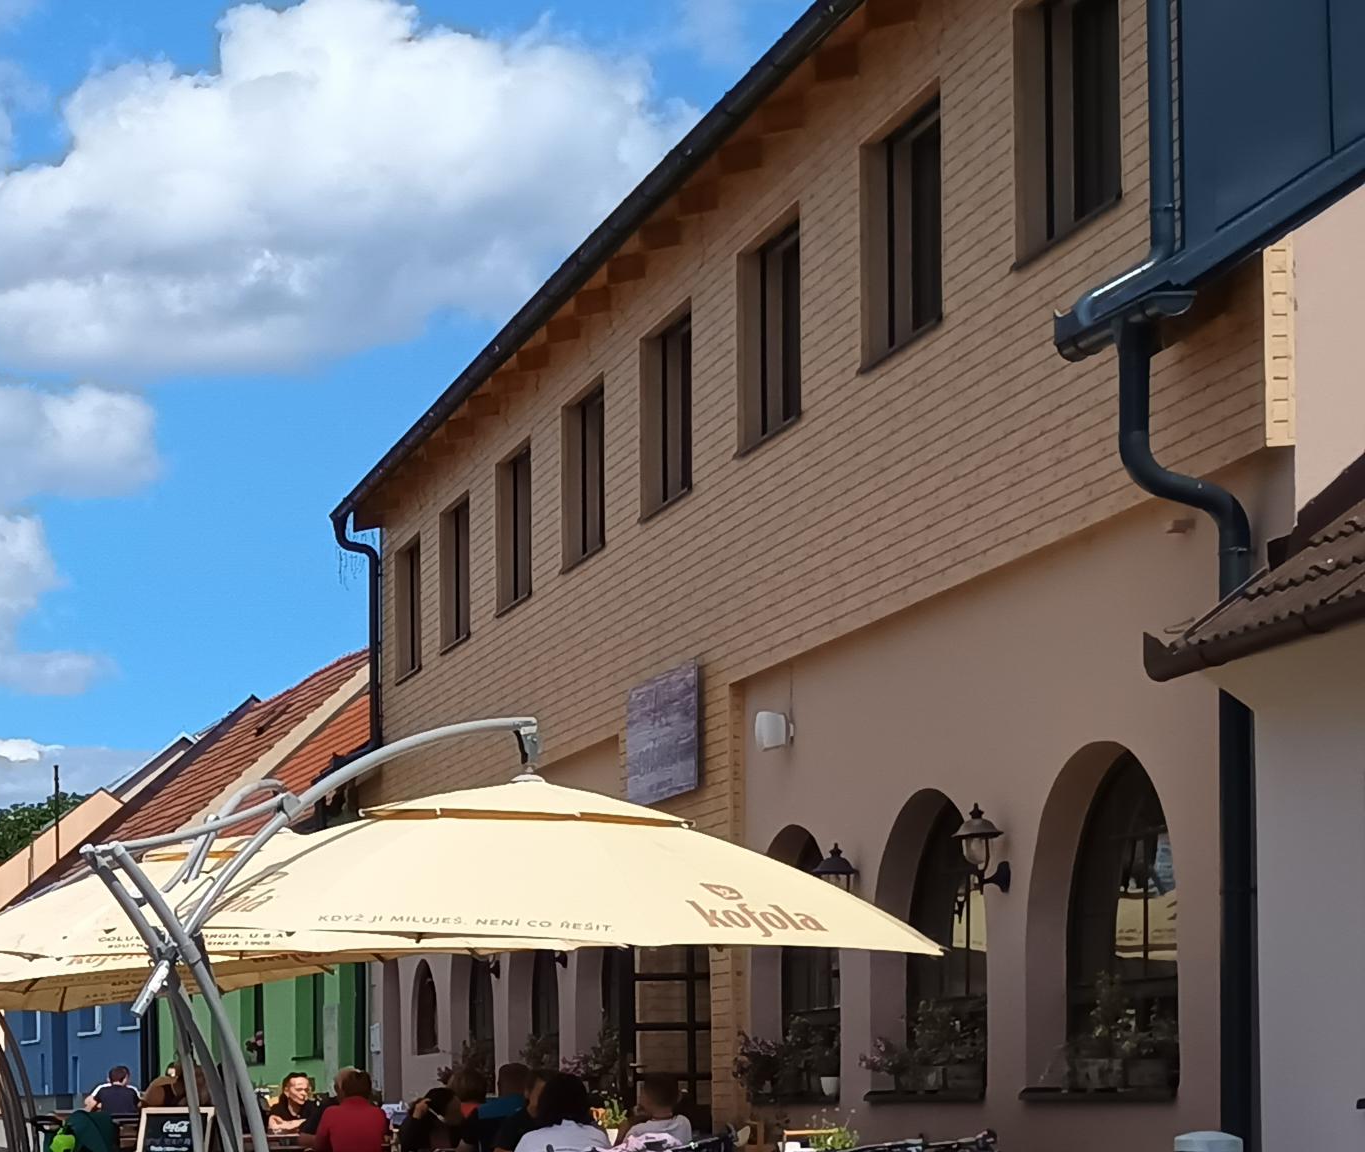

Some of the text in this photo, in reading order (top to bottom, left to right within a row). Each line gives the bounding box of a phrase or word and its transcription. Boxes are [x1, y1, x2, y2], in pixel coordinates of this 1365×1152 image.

[475, 917, 521, 928] NENÍ
[527, 919, 553, 928] CO
[685, 900, 829, 938] kofola
